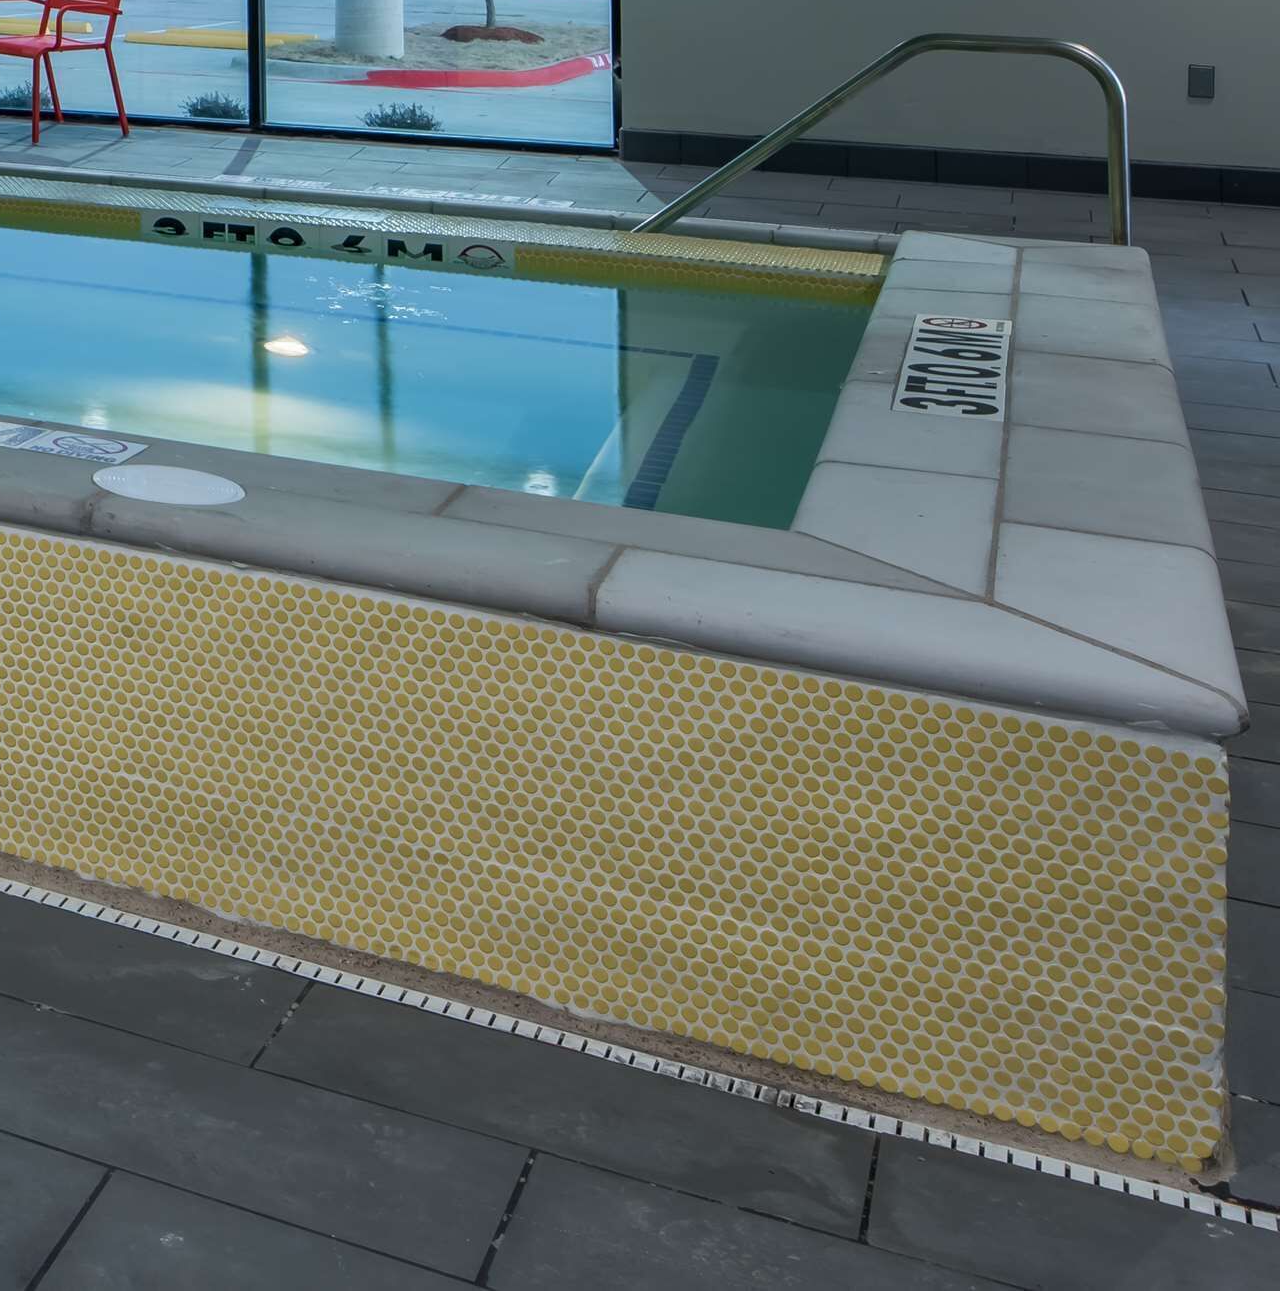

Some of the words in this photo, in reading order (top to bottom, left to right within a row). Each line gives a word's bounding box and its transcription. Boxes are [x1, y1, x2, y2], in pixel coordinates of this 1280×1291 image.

[203, 221, 255, 242] FT
[387, 239, 443, 262] M
[916, 328, 1003, 349] M
[900, 397, 999, 415] 3
[31, 445, 55, 453] NO
[57, 449, 117, 463] DIVING
